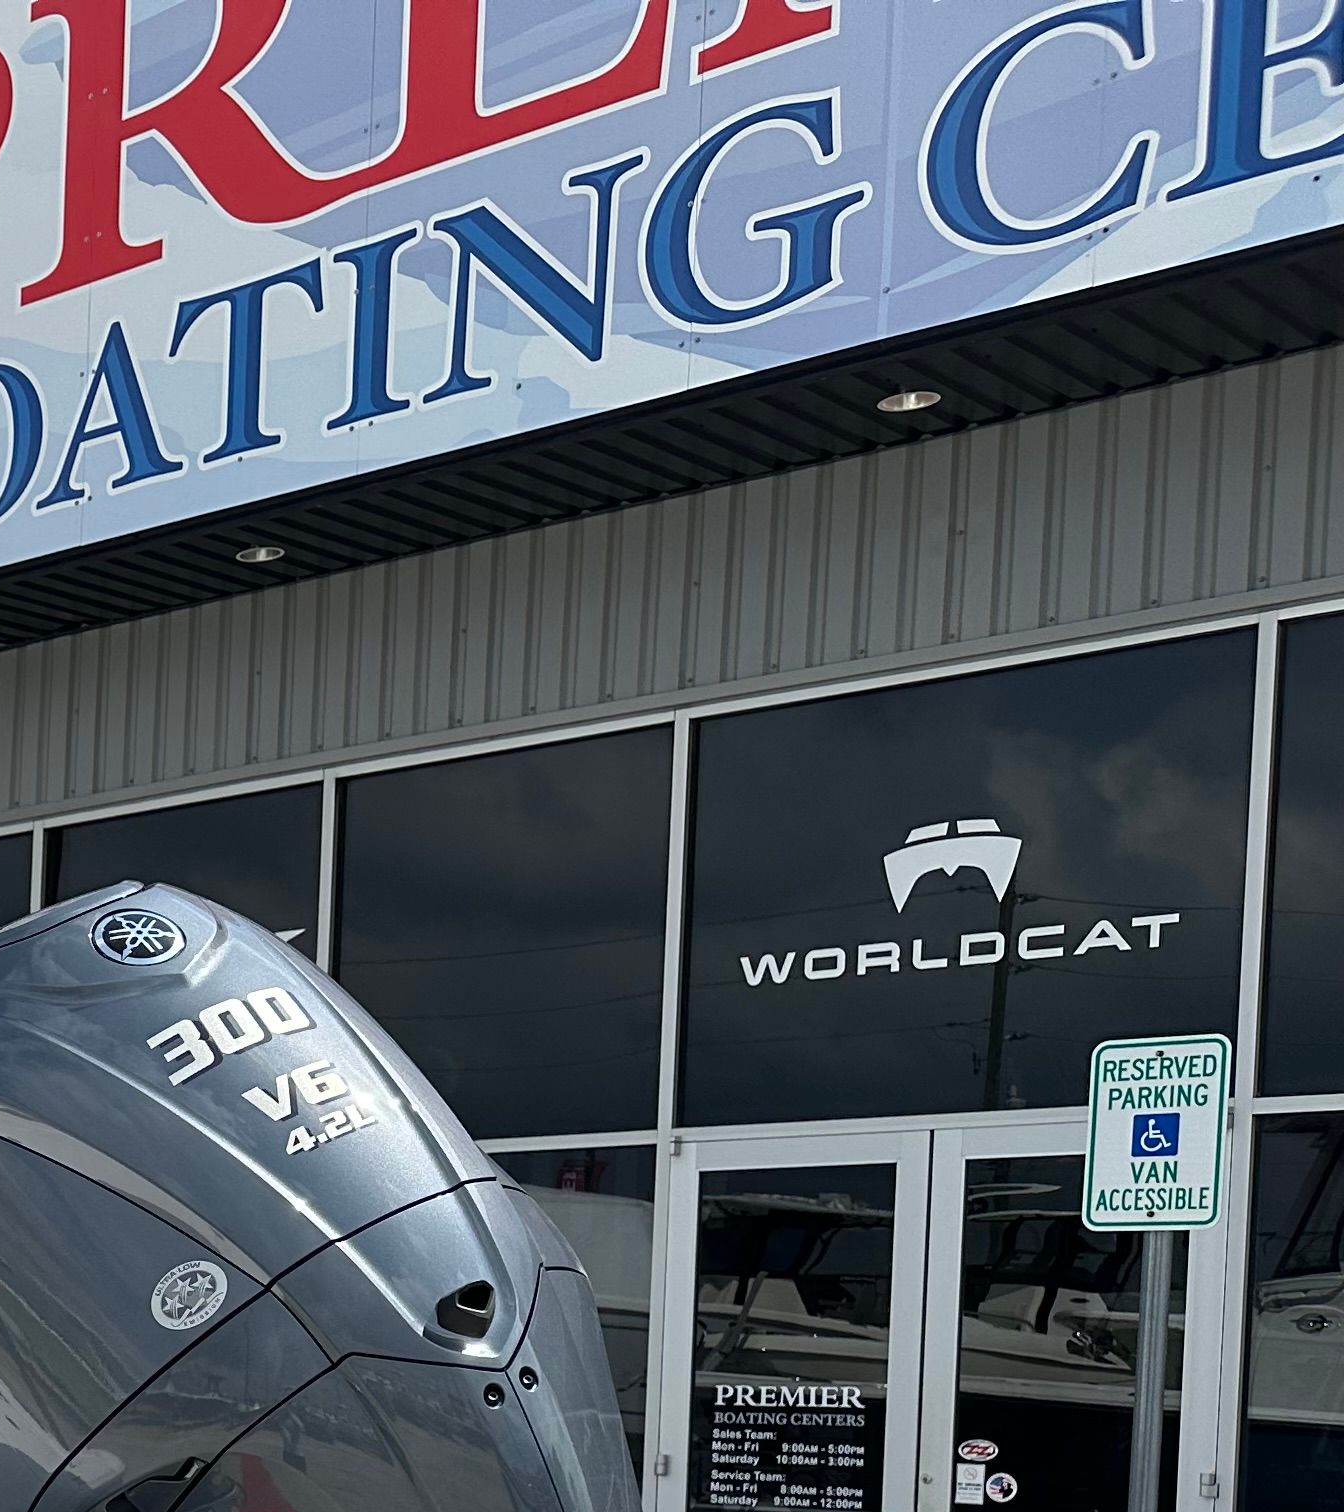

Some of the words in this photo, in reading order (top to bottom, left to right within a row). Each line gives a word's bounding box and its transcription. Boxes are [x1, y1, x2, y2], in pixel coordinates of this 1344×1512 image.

[739, 912, 1181, 987] WORLDCAT
[146, 986, 316, 1087] 300
[1102, 1053, 1218, 1083] RESERVED
[241, 1058, 349, 1122] V6
[1107, 1083, 1210, 1111] PARKING
[285, 1102, 379, 1155] 4.2L
[1129, 1160, 1179, 1184] VAN
[1094, 1186, 1211, 1213] ACCESSIBLE
[714, 1384, 865, 1409] PREMIER
[714, 1411, 787, 1426] BOATING
[790, 1413, 865, 1427] CENTERS
[712, 1428, 742, 1439] Sales
[745, 1430, 777, 1440] Team:
[712, 1441, 735, 1451] Mon
[744, 1442, 759, 1452] Fri
[712, 1452, 759, 1466] Saturday
[710, 1482, 733, 1492] Mon
[742, 1483, 757, 1493] Fri
[711, 1470, 751, 1480] Service
[754, 1471, 786, 1482] Team:
[710, 1494, 758, 1507] Saturday
